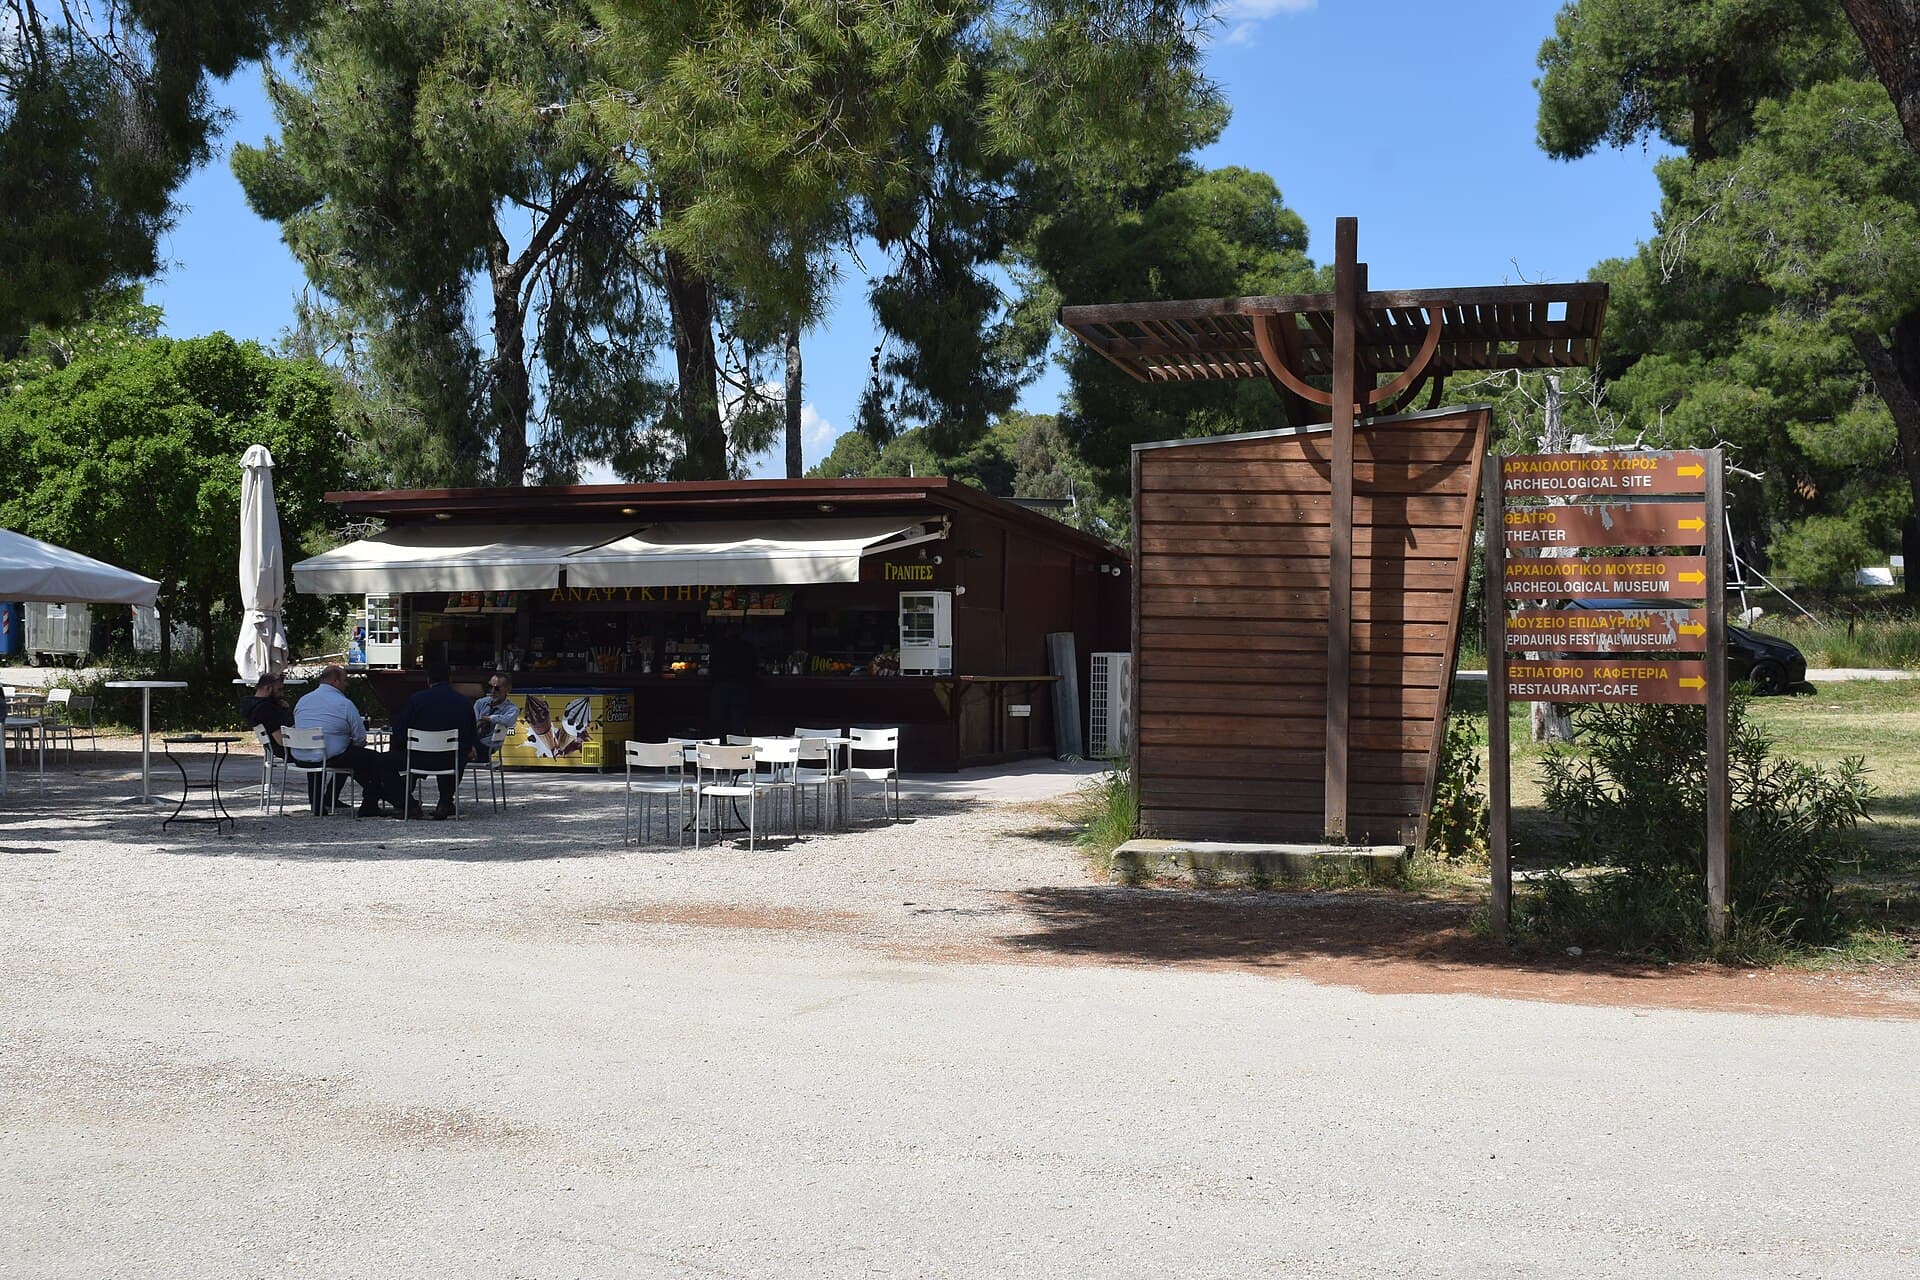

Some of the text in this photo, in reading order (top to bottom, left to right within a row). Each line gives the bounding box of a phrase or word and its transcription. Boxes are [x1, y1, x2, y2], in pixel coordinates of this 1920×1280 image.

[1504, 458, 1658, 473] ΑΡΧΑΙΟΛΟΓΙΚΟΣ ΧΩΡΟΣ
[1504, 475, 1652, 490] ARCHEOLOGICAL SITE
[1504, 512, 1556, 525] ΘΕΑΤΡΟ
[1504, 530, 1566, 542] THEATER
[1506, 563, 1666, 576] ΑΡΧΑΙΟΛΟΓΙΚΟ ΜΟΥΣΕΙΟ
[1506, 580, 1670, 593] ARCHEOLOGICAL MUSEUM
[550, 585, 738, 602] ΑΝΑΨΥΚΤΗΡ
[1507, 616, 1565, 629] ΜΟΥΣΕΙΟ
[1507, 633, 1672, 646] EPIDAURUS FESTIVAL MUSEUM
[1508, 667, 1669, 679] ΕΣΤΙΑΤΟΡΙΟ ΚΑΦΕΤΕΡΙΑ
[1509, 683, 1638, 696] RESTAURANT-CAFE
